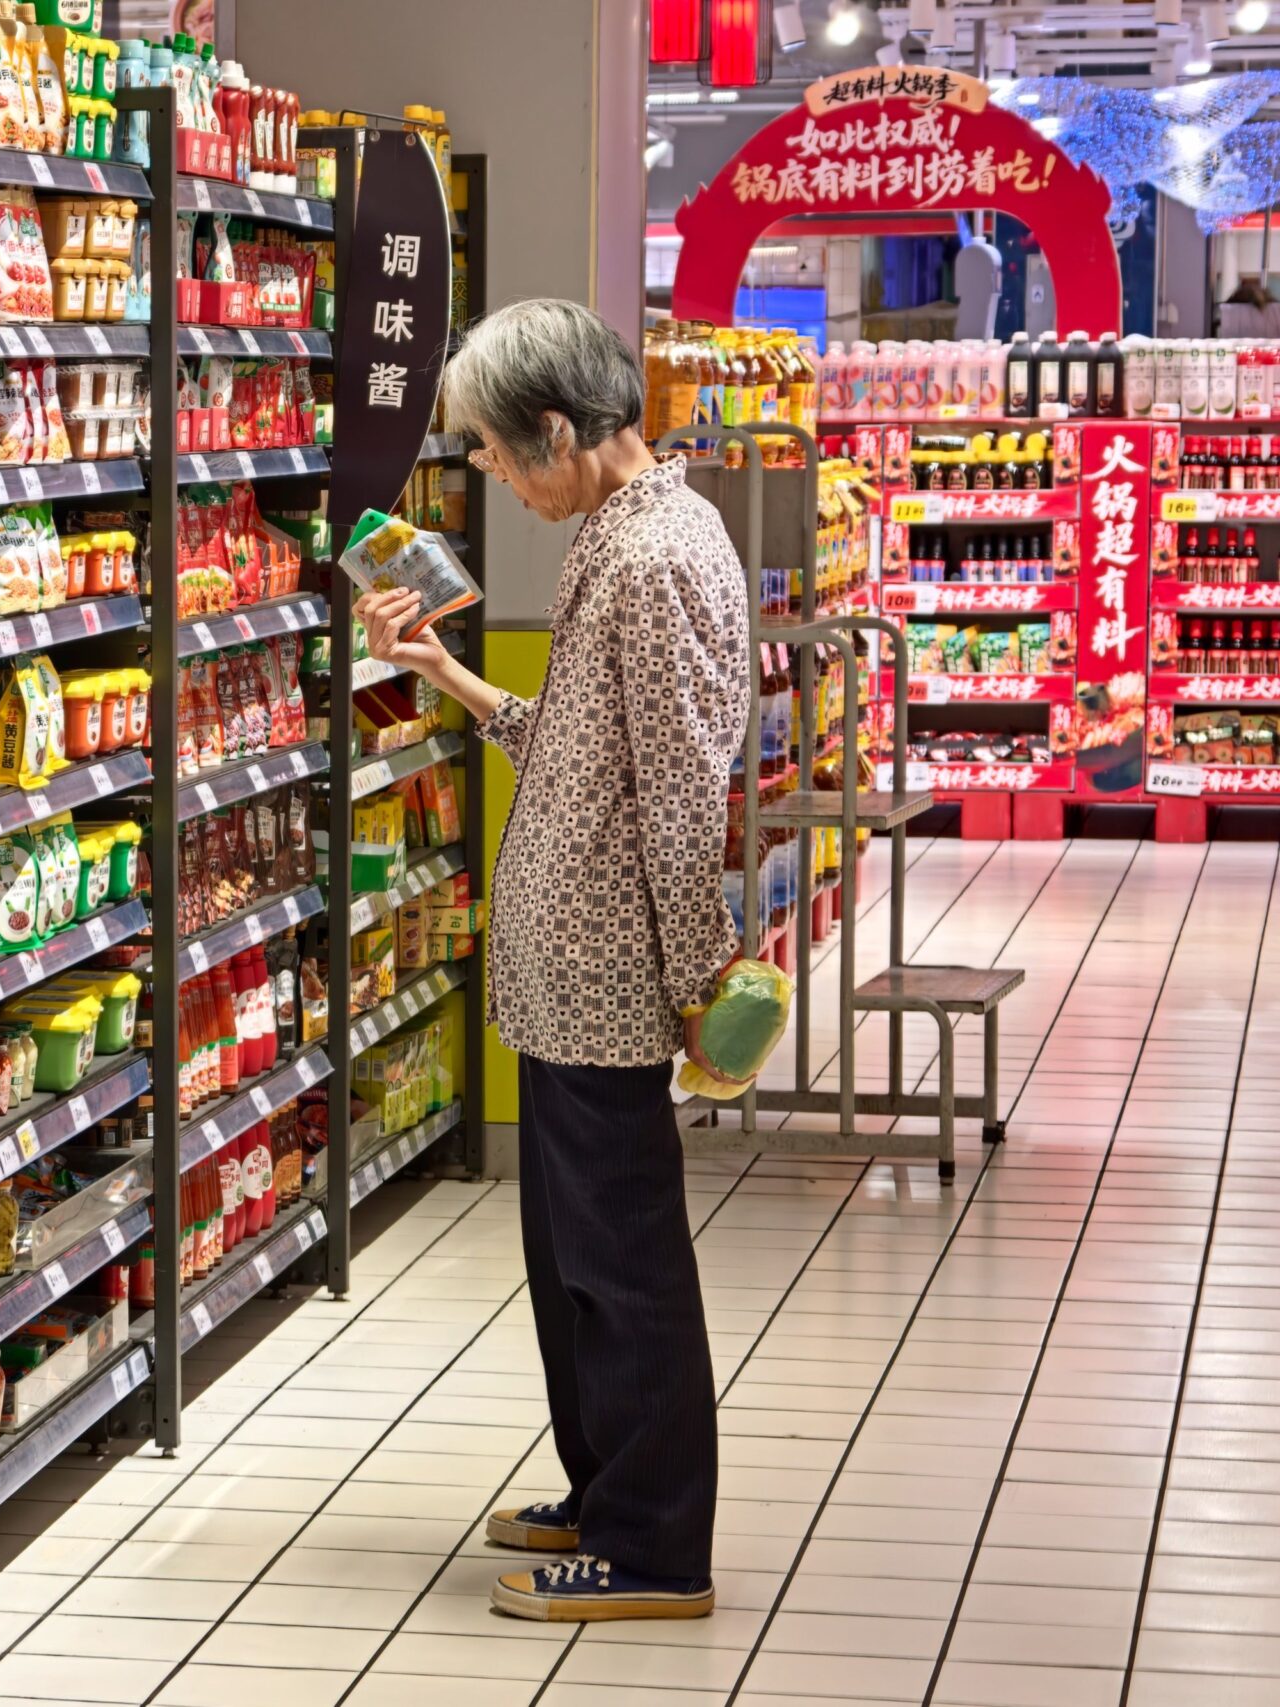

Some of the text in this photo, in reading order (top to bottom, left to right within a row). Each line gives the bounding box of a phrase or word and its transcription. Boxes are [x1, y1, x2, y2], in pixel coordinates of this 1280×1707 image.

[367, 233, 421, 409] 调味酱
[1083, 434, 1146, 662] 火锅超有料
